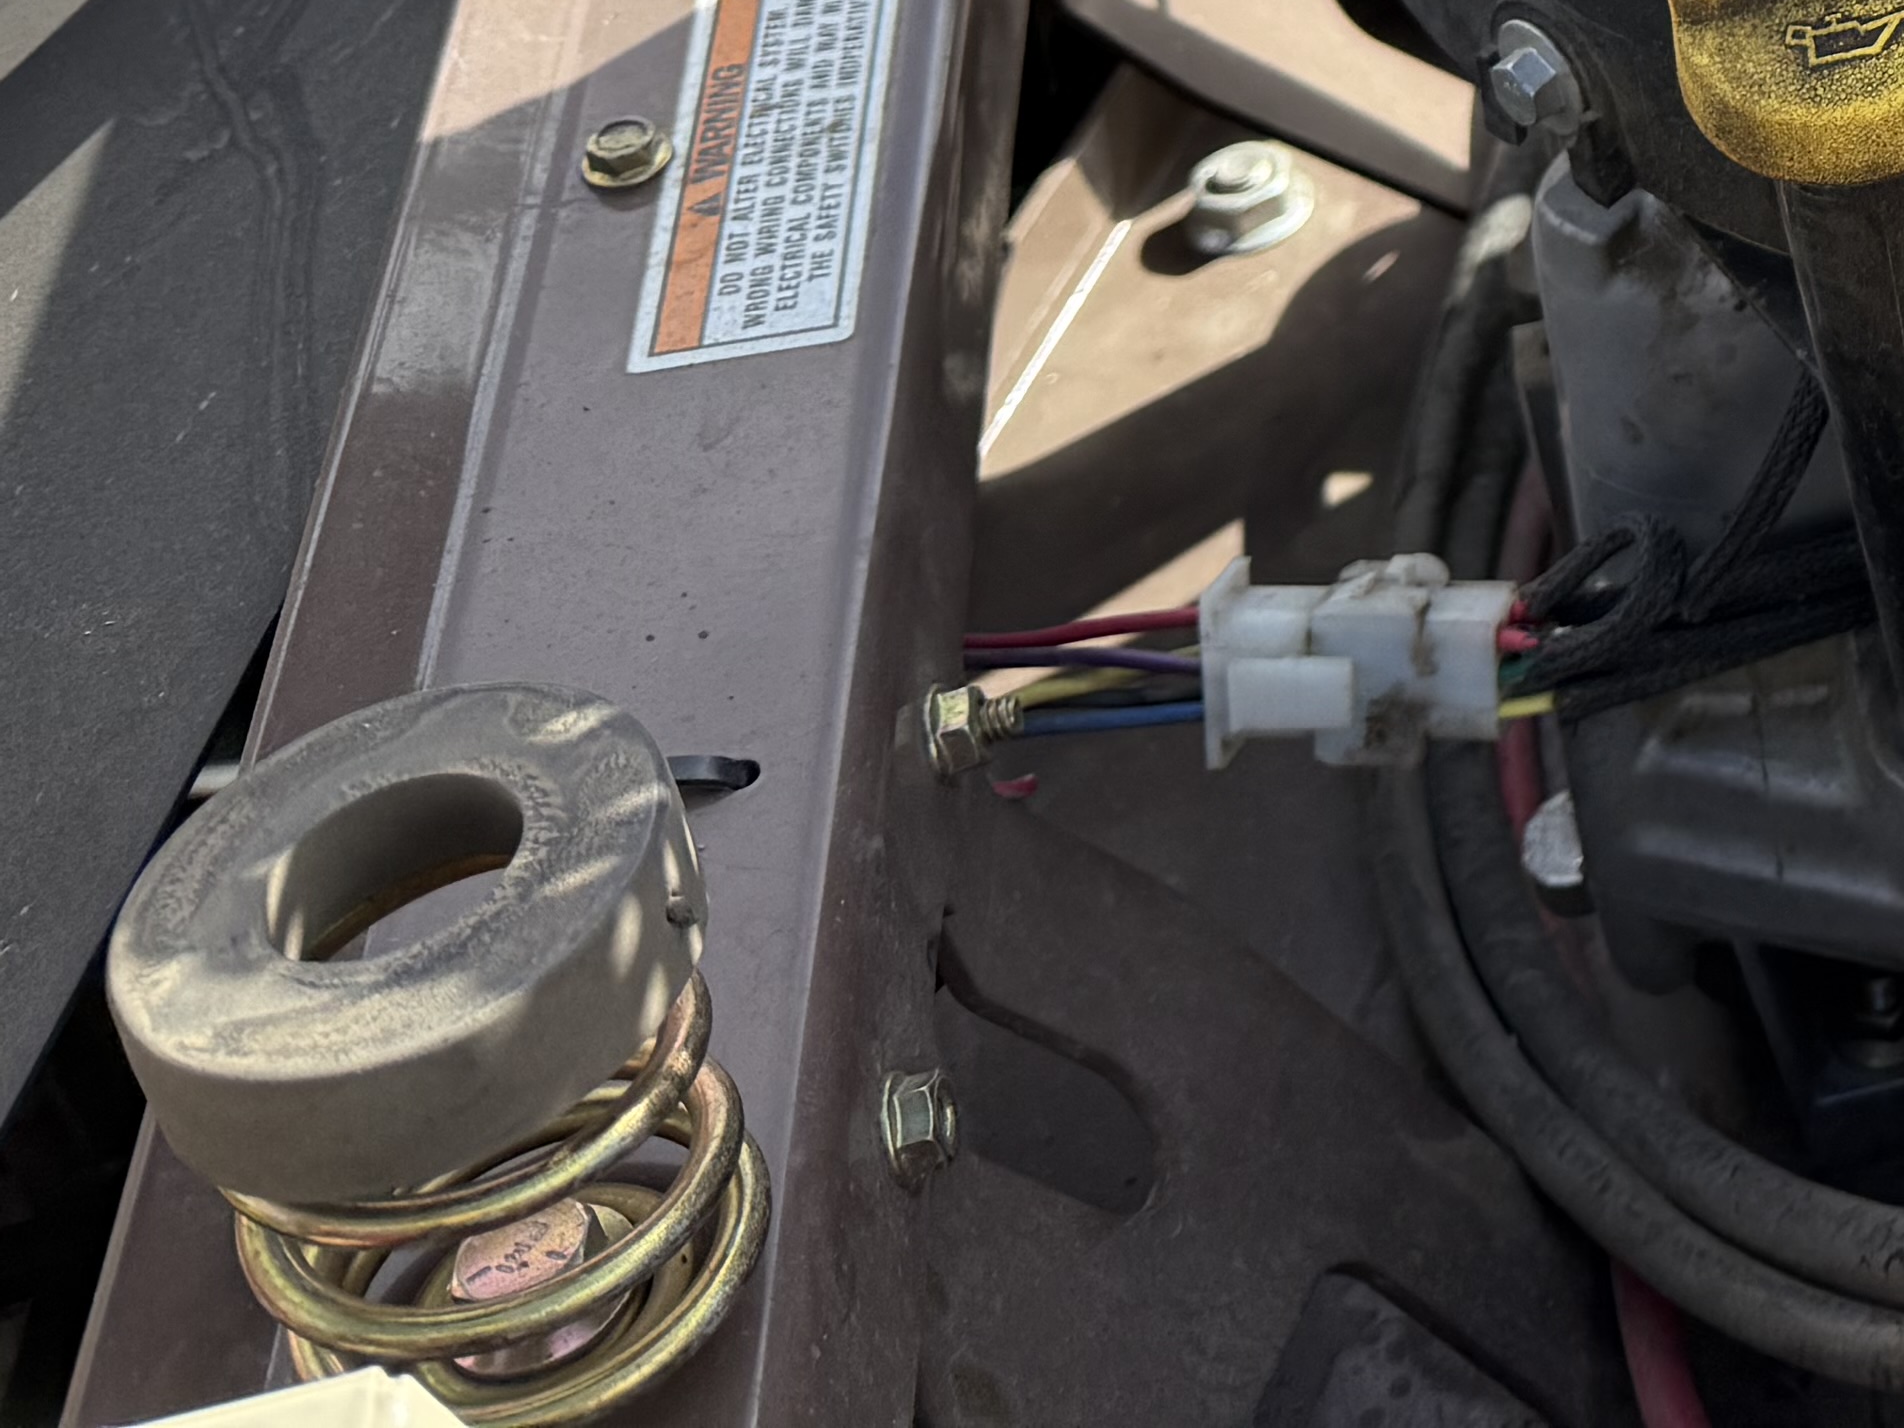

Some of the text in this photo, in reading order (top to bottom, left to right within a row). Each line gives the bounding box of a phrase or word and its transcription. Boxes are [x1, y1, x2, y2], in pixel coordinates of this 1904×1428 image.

[783, 36, 811, 72] WILL
[809, 59, 835, 90] AND
[687, 63, 744, 184] WARNING
[741, 75, 777, 166] ELECTRICAL
[765, 79, 804, 188] CONNECTIONS
[791, 97, 829, 206] COMPONENTS
[824, 95, 856, 174] SWITCHES
[731, 173, 761, 221] ALTER
[755, 195, 786, 258] WIRING
[814, 182, 844, 242] SAFETY
[723, 232, 752, 264] NOT
[774, 212, 811, 312] ELECTRICAL
[808, 248, 835, 282] THE
[718, 271, 744, 297] DO
[742, 264, 774, 330] WRONG
